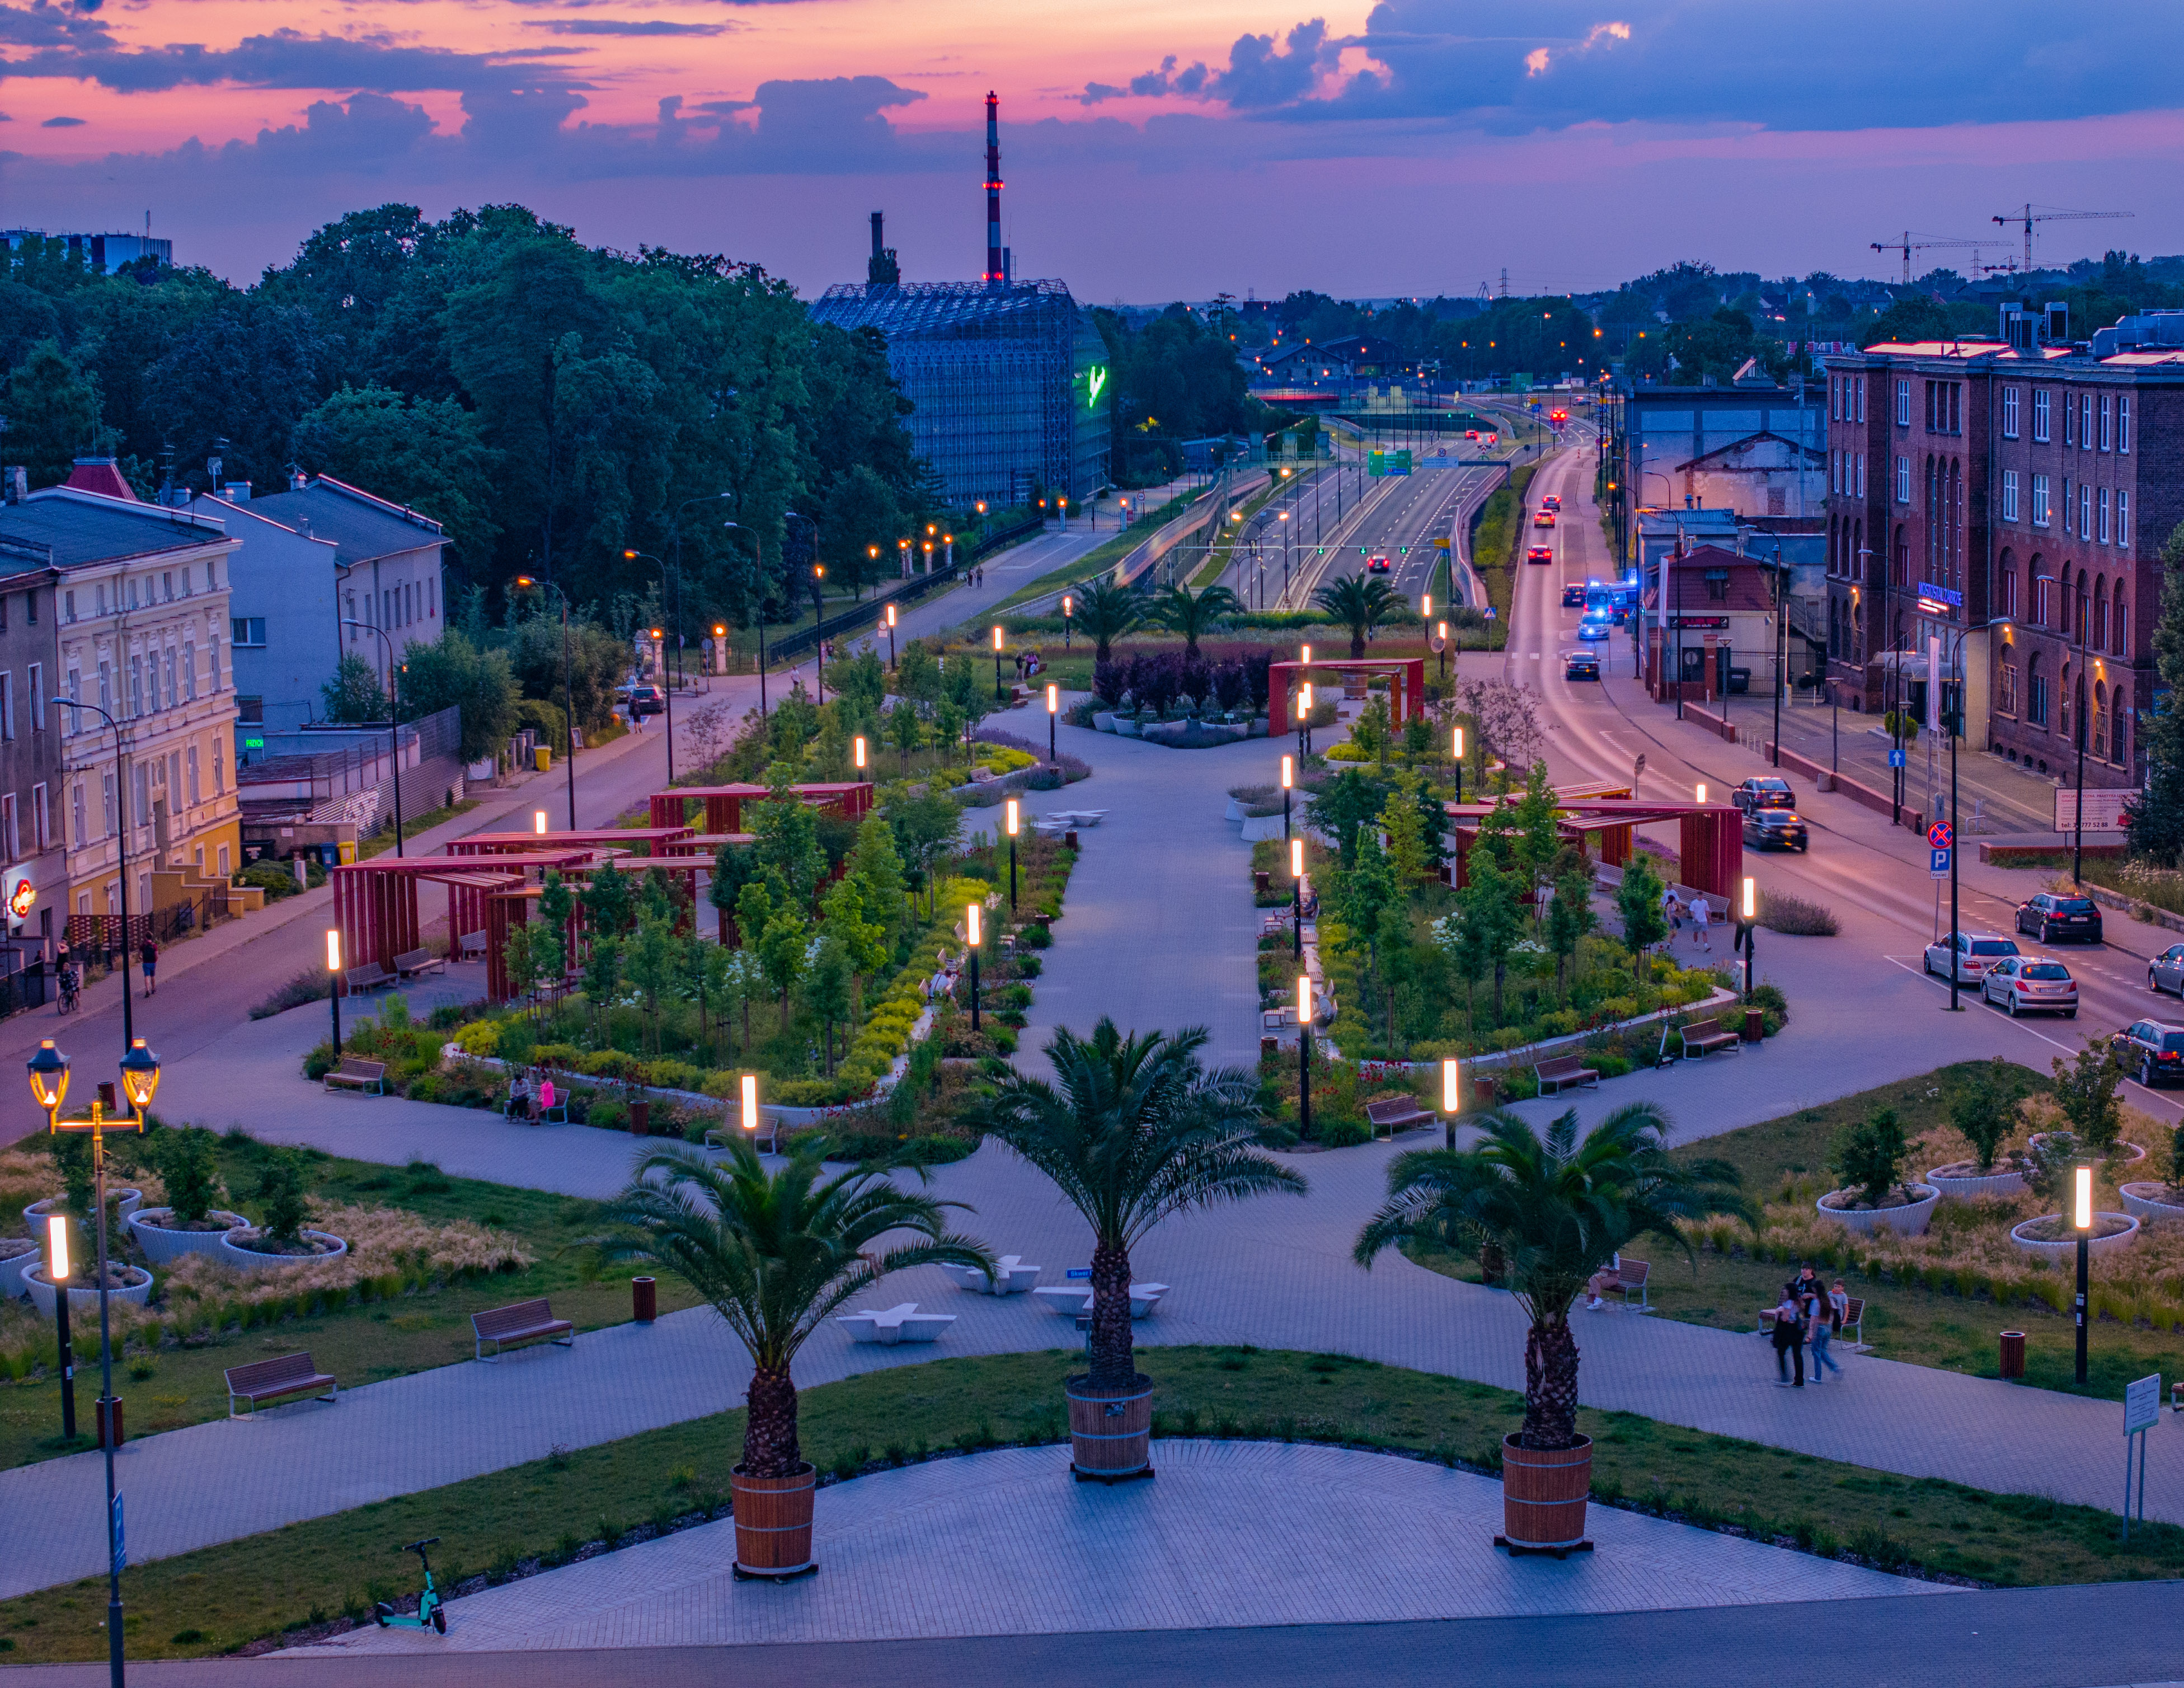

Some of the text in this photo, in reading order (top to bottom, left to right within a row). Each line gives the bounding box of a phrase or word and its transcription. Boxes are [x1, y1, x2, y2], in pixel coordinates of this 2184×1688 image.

[1918, 582, 1961, 607] MOSTOSTAL ZABRZE
[1935, 851, 1946, 868] P
